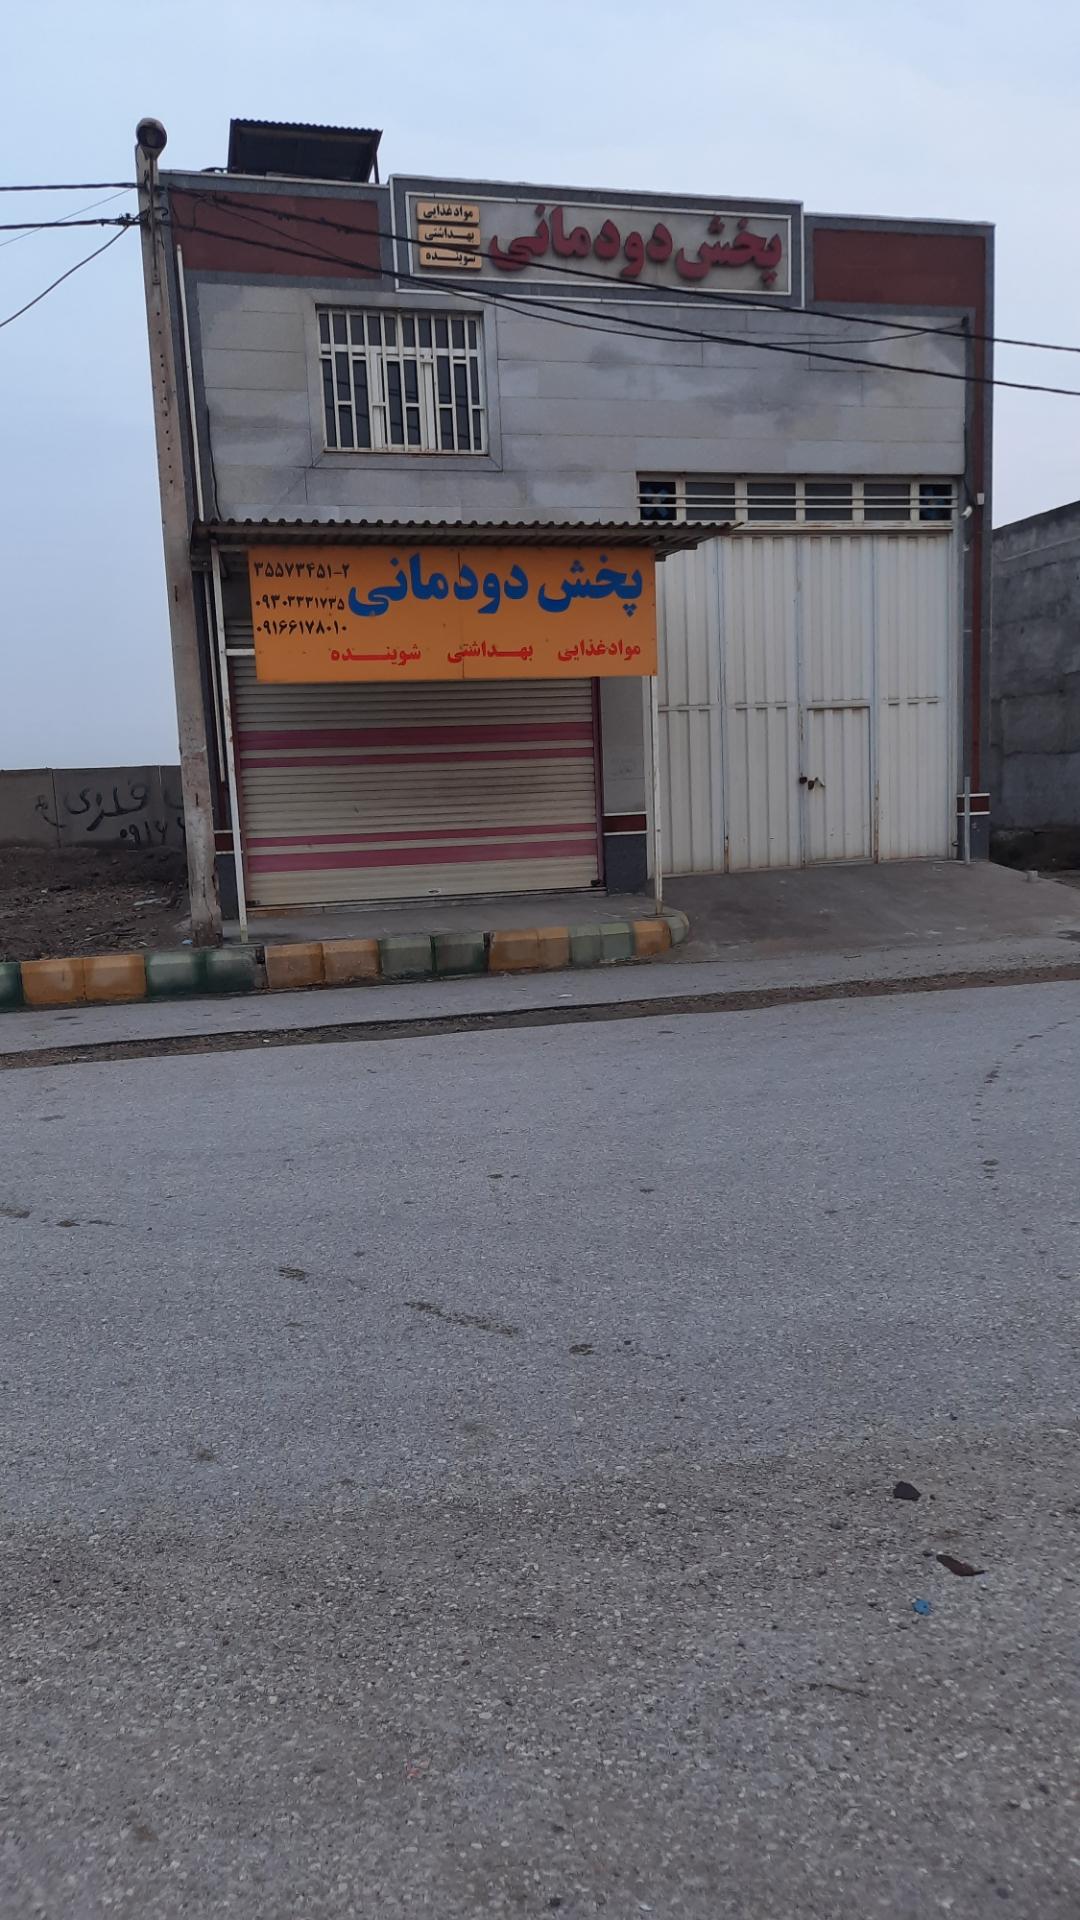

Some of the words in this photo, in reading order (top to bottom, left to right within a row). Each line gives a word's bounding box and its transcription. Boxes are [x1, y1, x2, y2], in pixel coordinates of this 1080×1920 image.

[424, 227, 475, 244] بهداشتی
[489, 203, 673, 279] دودمانی
[675, 214, 782, 290] پخش
[347, 551, 529, 617] دودمانی
[537, 554, 643, 617] پخش
[256, 619, 347, 635] ۰۹۱۶۶۱۷۸۰۱۰
[330, 643, 421, 666] شوینده
[447, 638, 534, 664] بهداشتی
